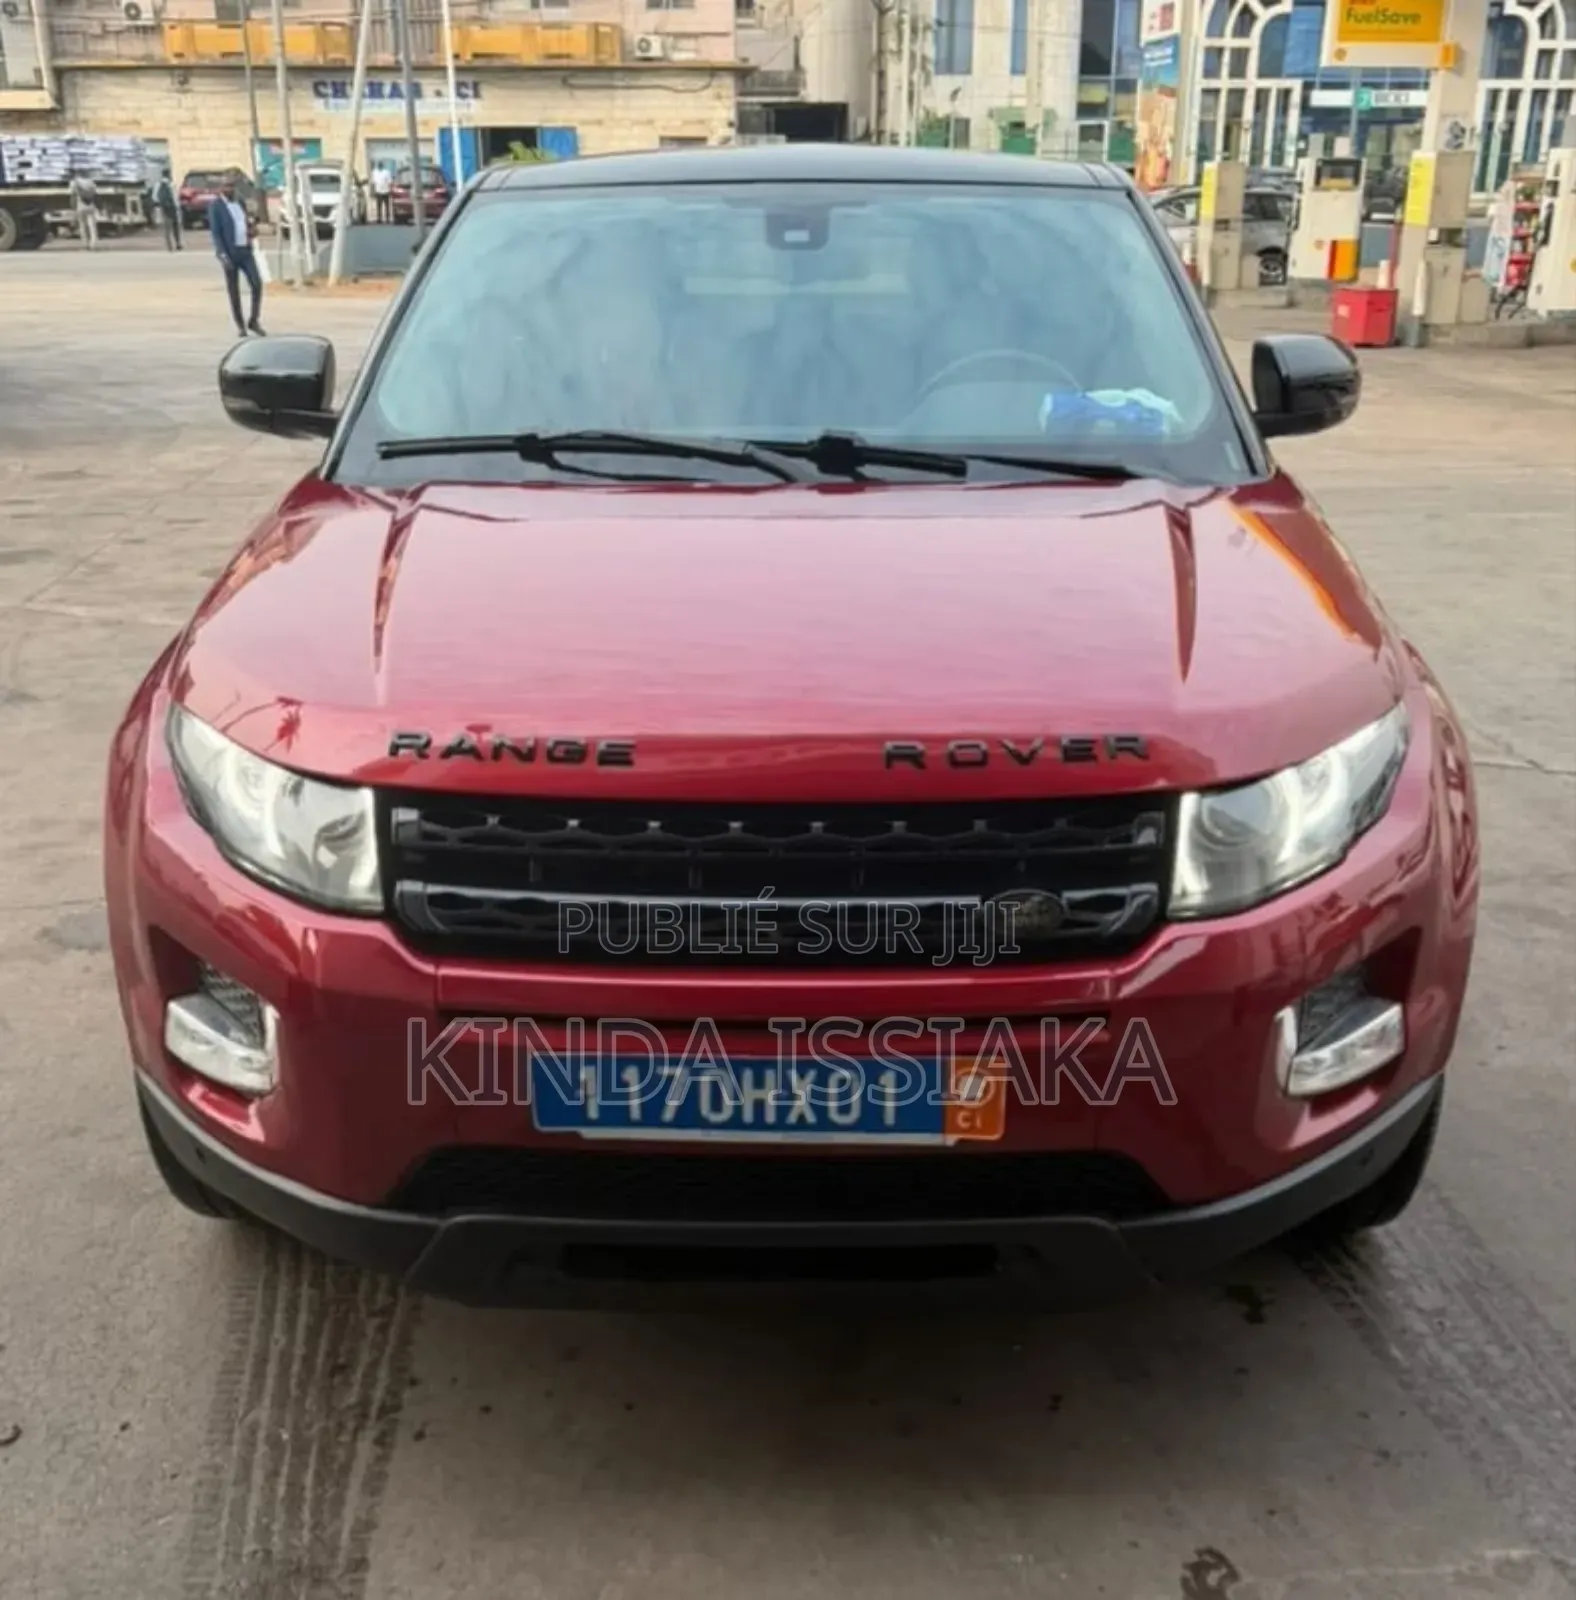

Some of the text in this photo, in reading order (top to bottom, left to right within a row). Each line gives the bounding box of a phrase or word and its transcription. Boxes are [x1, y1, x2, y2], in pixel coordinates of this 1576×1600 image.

[1346, 6, 1422, 25] FuelSave
[388, 731, 1151, 770] RANGE ROVER
[579, 1064, 898, 1127] 1170HX01
